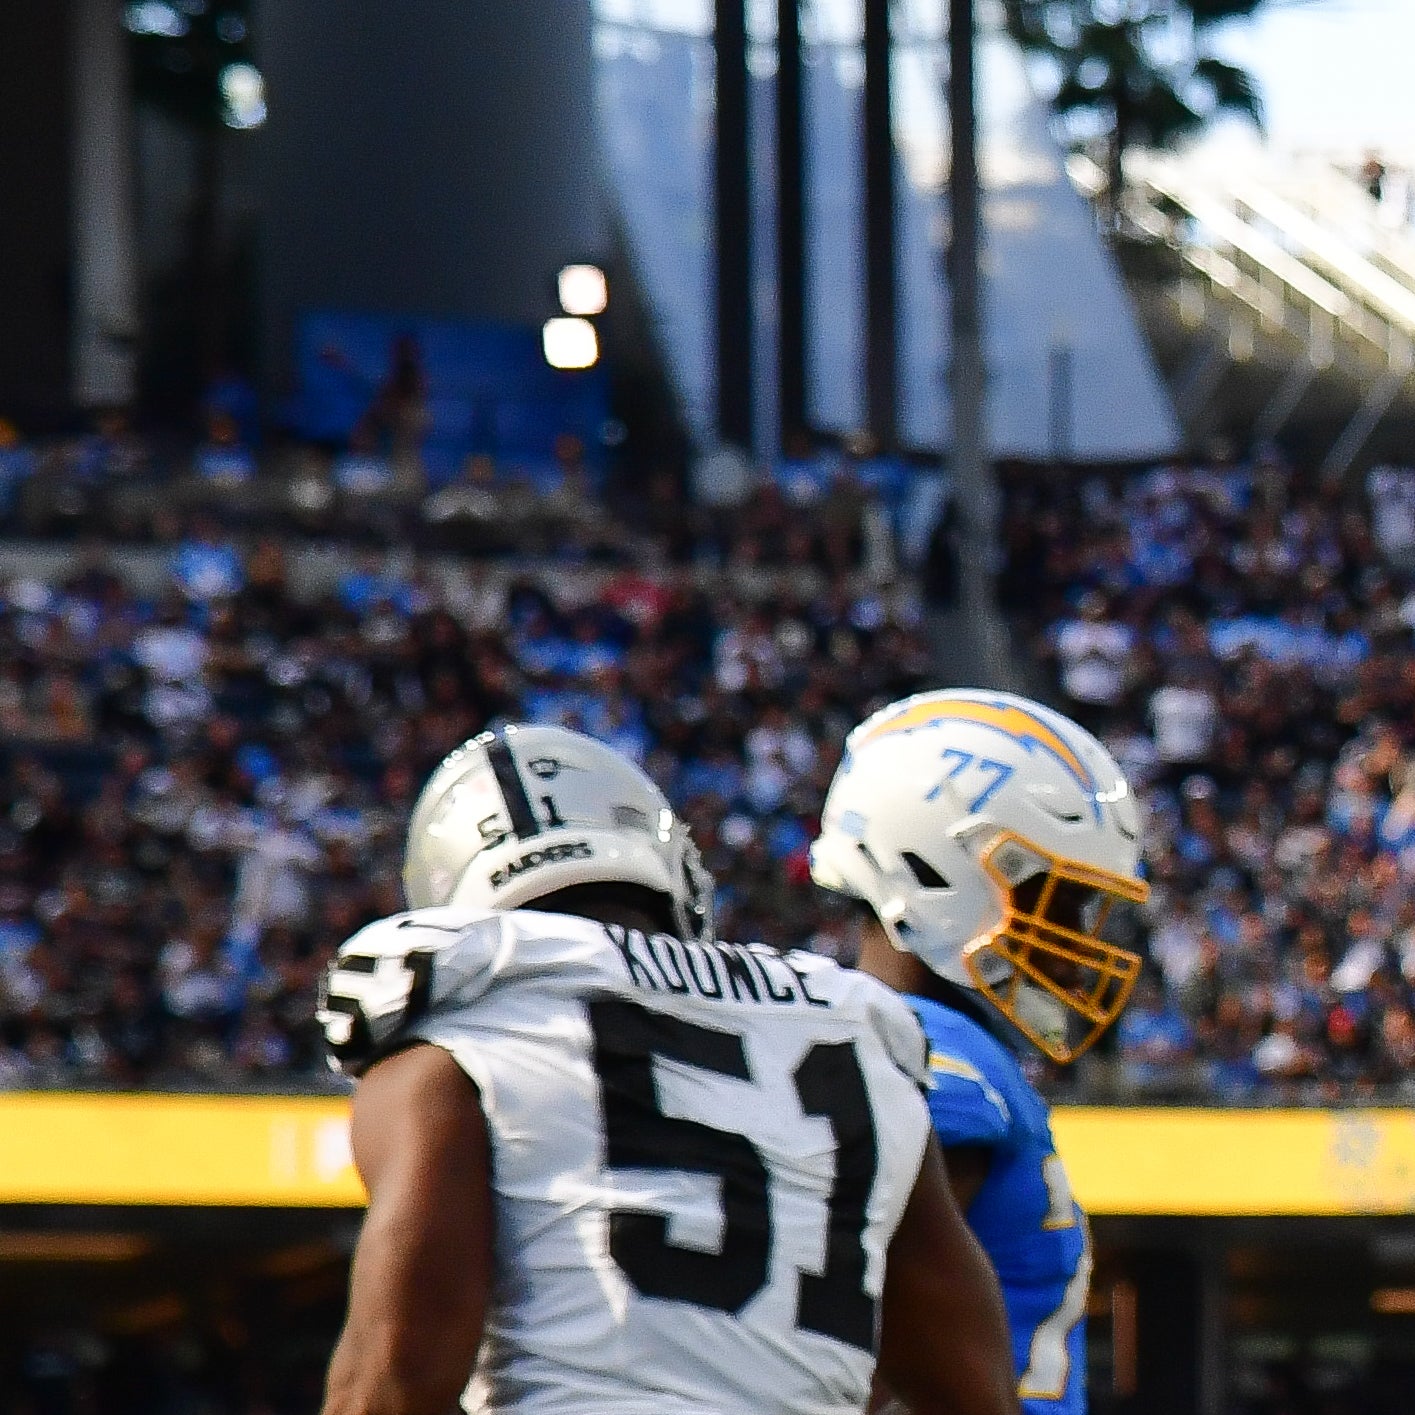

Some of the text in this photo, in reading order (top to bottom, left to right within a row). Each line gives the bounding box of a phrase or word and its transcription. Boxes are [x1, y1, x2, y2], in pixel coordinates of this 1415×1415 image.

[924, 747, 1015, 815] 77
[603, 922, 833, 1009] KOUNCE
[587, 1001, 881, 1354] 51
